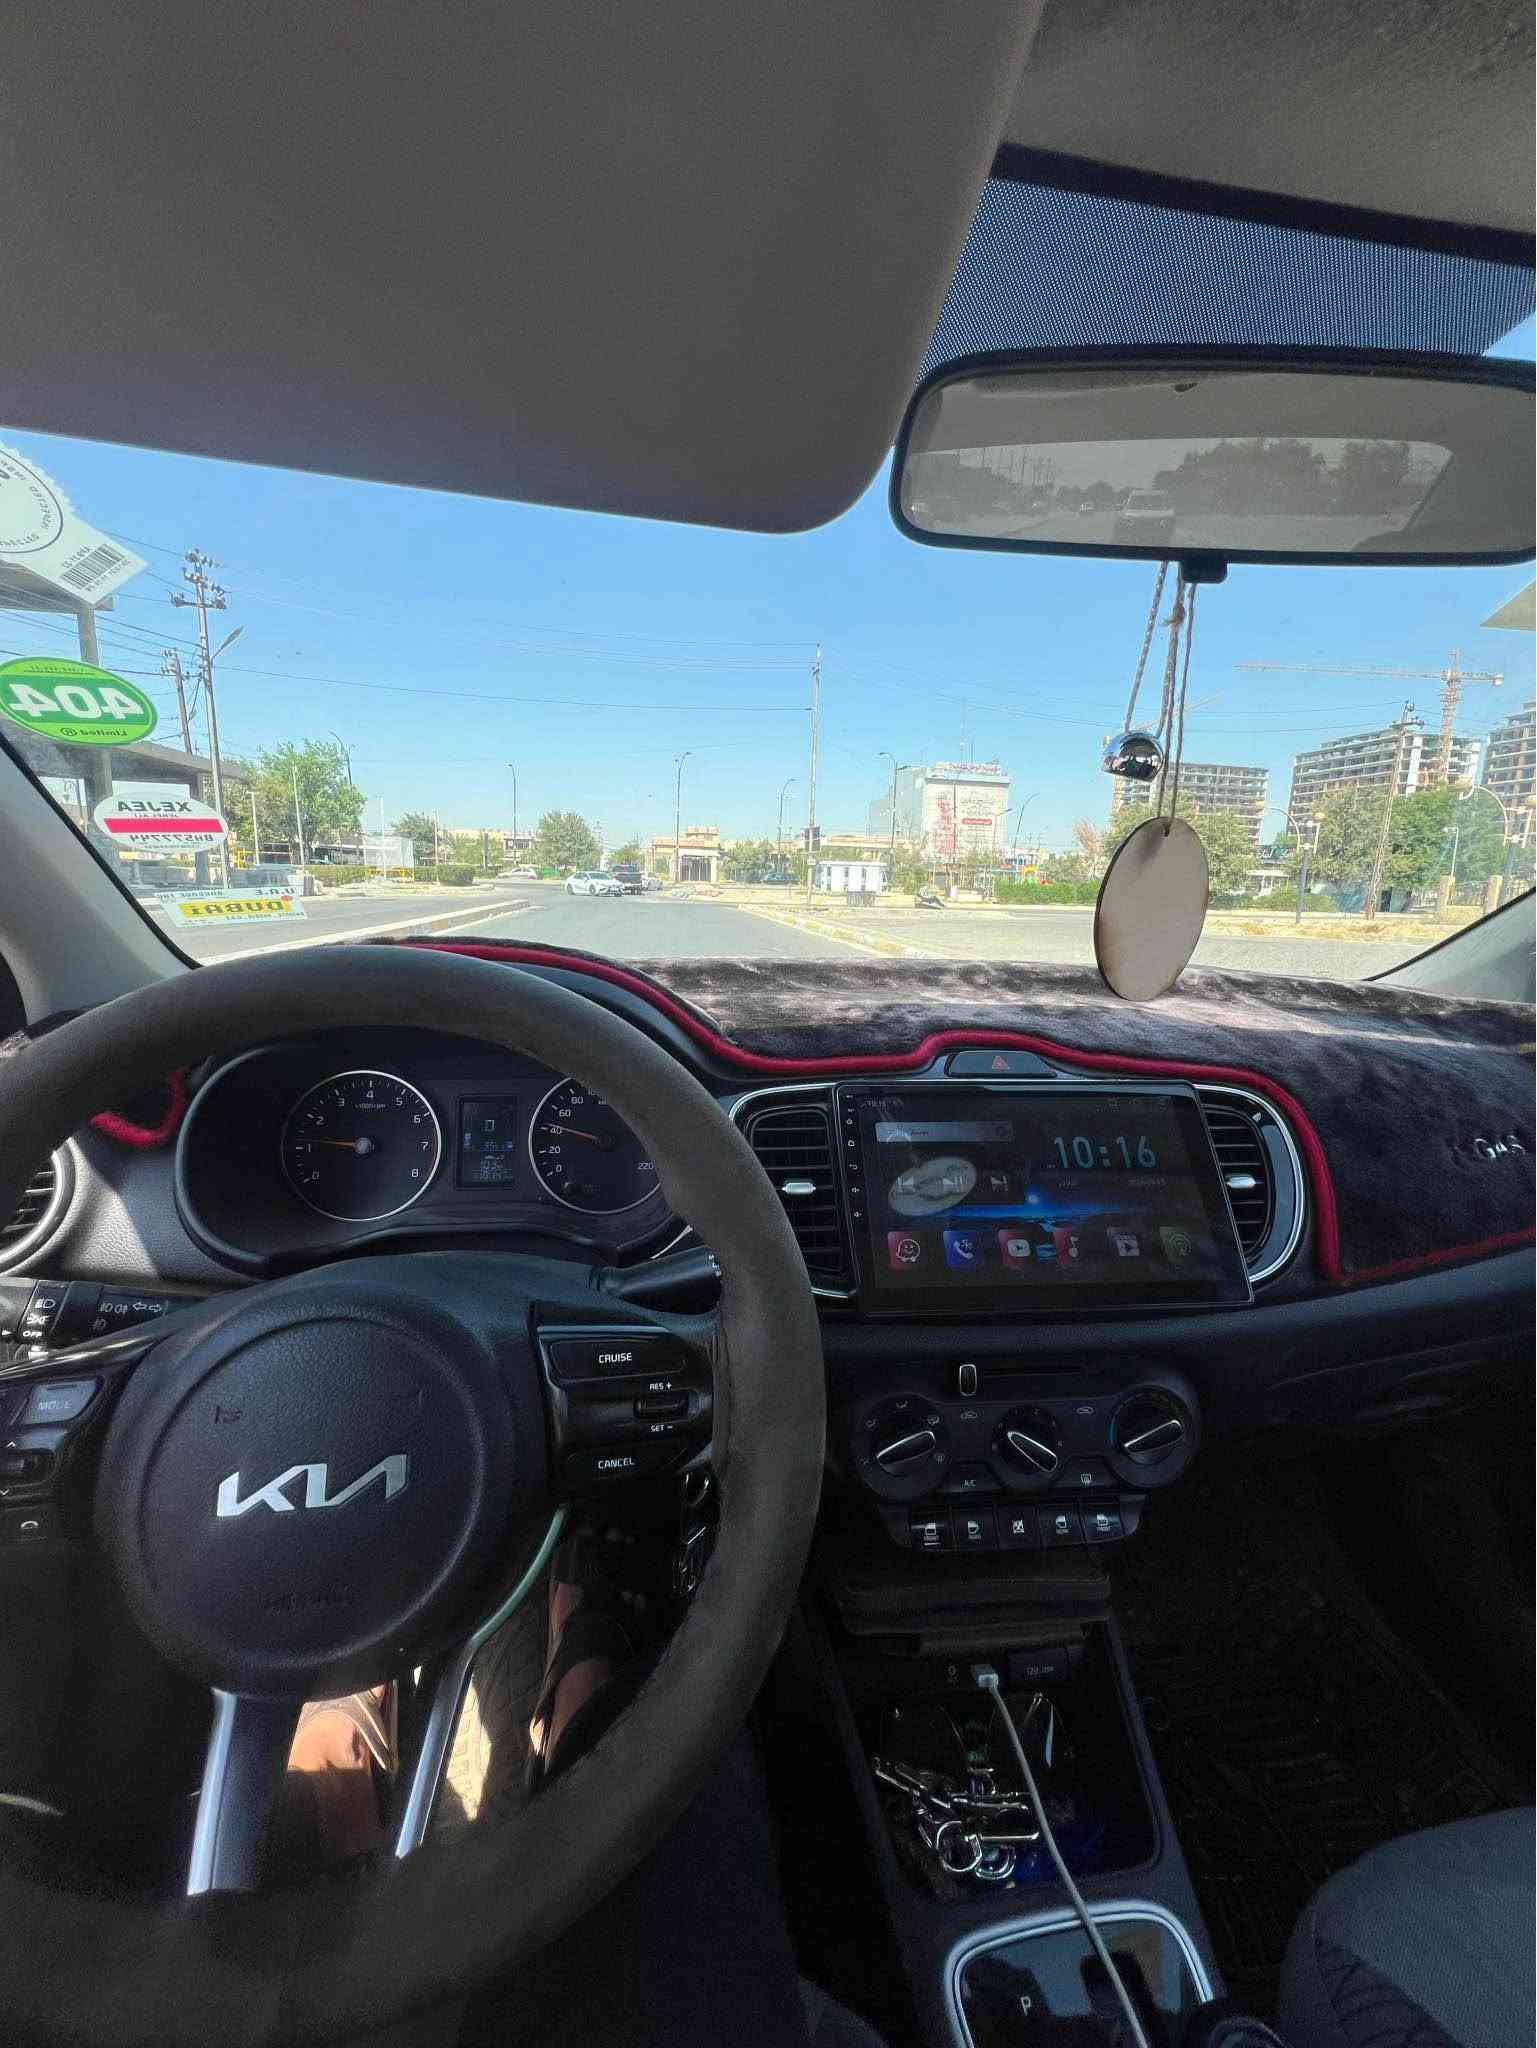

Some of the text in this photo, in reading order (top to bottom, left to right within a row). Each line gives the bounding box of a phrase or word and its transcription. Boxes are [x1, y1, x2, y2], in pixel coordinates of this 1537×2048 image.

[366, 1090, 374, 1099] 4
[395, 1098, 403, 1106] 5
[558, 1109, 571, 1118] 60
[413, 1114, 421, 1123] 6
[420, 1141, 429, 1151] 7
[548, 1146, 561, 1155] 20
[1054, 1136, 1156, 1169] 10:16
[555, 1163, 562, 1173] 0
[638, 1161, 655, 1170] 220
[411, 1168, 419, 1178] 8
[598, 1352, 633, 1364] CRUISE
[650, 1383, 664, 1391] RES
[650, 1424, 664, 1433] SET
[597, 1457, 635, 1469] CANCEL
[216, 1454, 408, 1517] KIA
[1020, 1995, 1031, 2016] P
